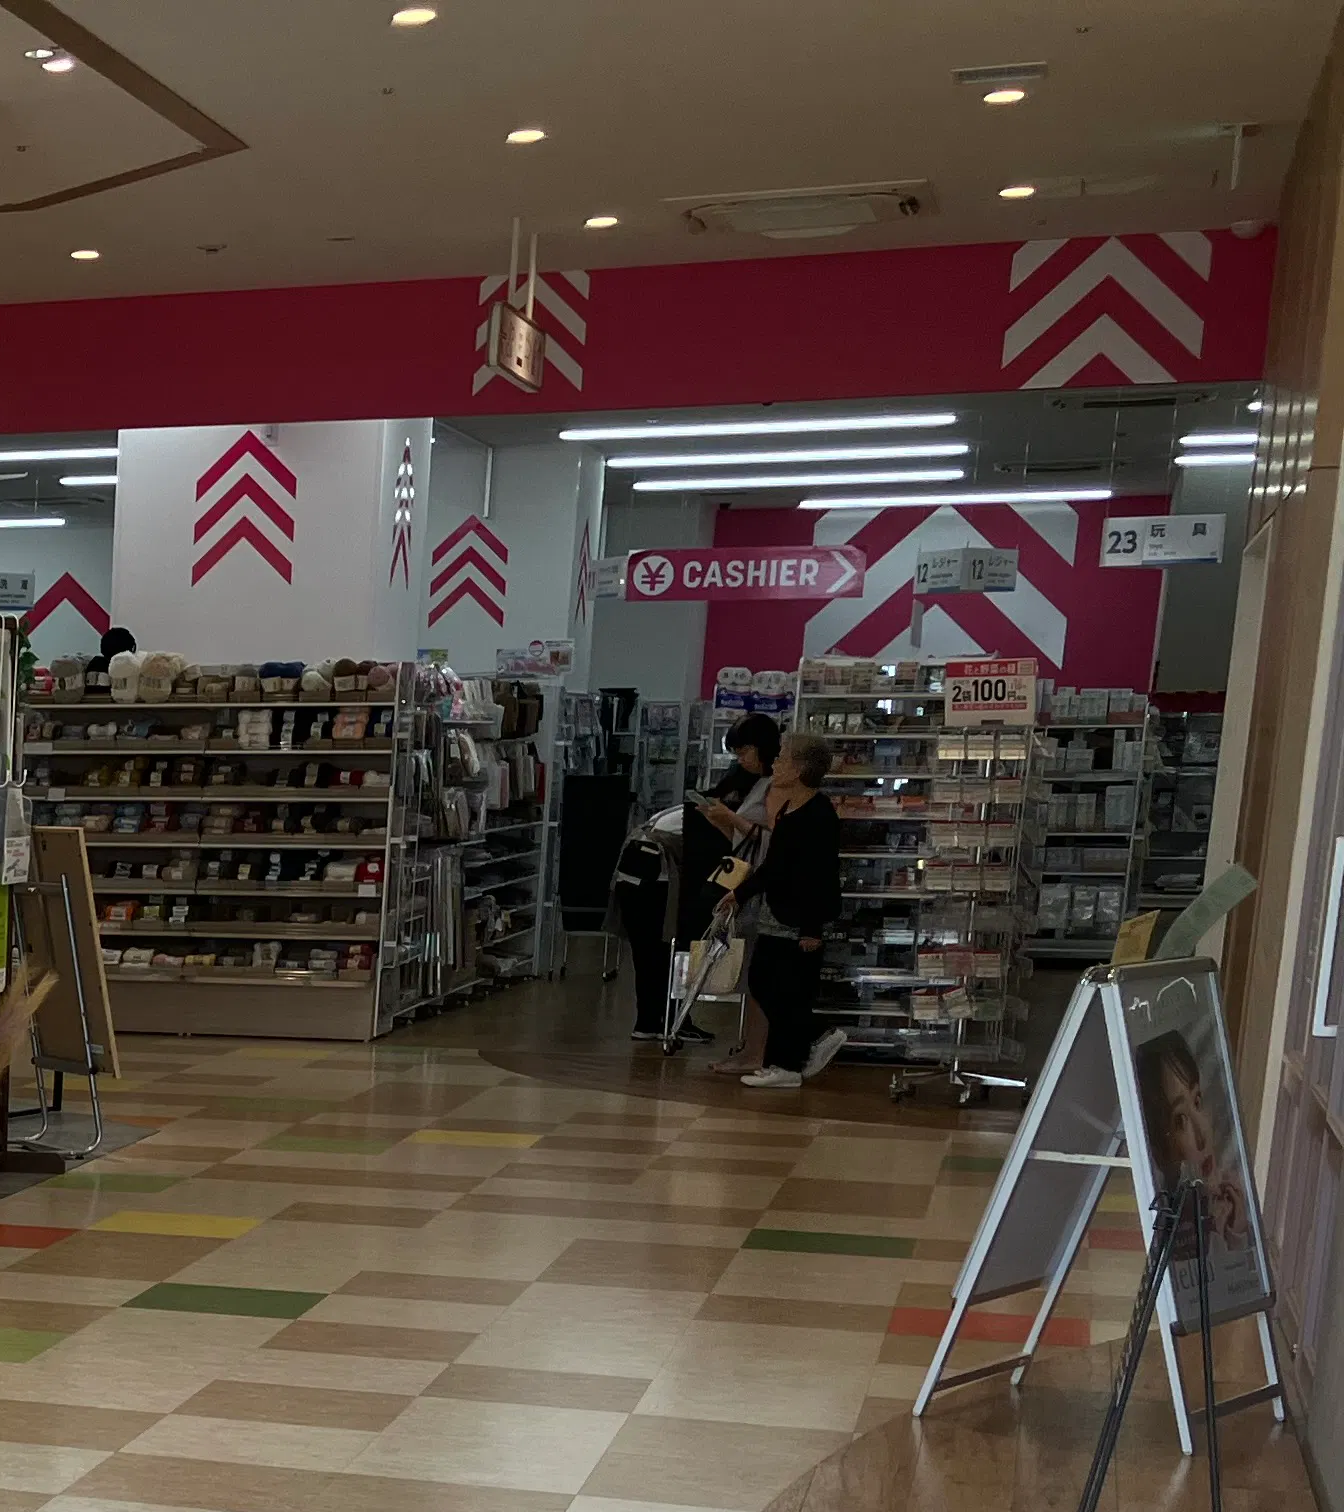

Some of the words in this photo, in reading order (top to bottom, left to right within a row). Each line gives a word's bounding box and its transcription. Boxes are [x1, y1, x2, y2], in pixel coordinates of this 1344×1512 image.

[1106, 530, 1138, 554] 23
[682, 558, 820, 588] CASHIER
[917, 563, 929, 583] 12
[972, 559, 985, 580] 12
